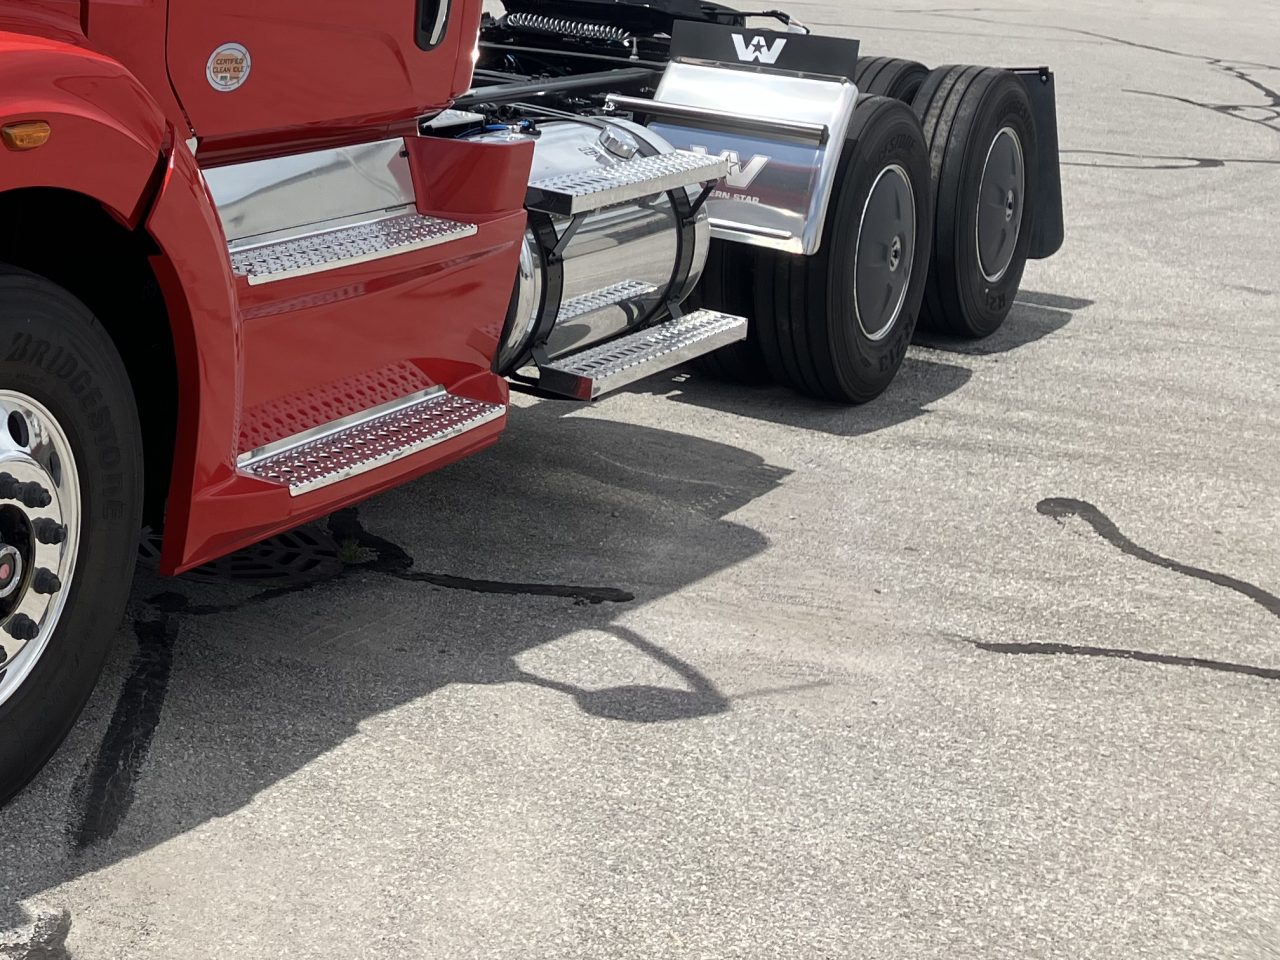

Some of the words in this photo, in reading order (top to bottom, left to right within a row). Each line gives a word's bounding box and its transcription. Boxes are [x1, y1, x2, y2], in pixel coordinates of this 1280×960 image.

[213, 66, 231, 74] CLEAN
[733, 193, 760, 204] STAR
[5, 331, 126, 520] BRIDGESTONE
